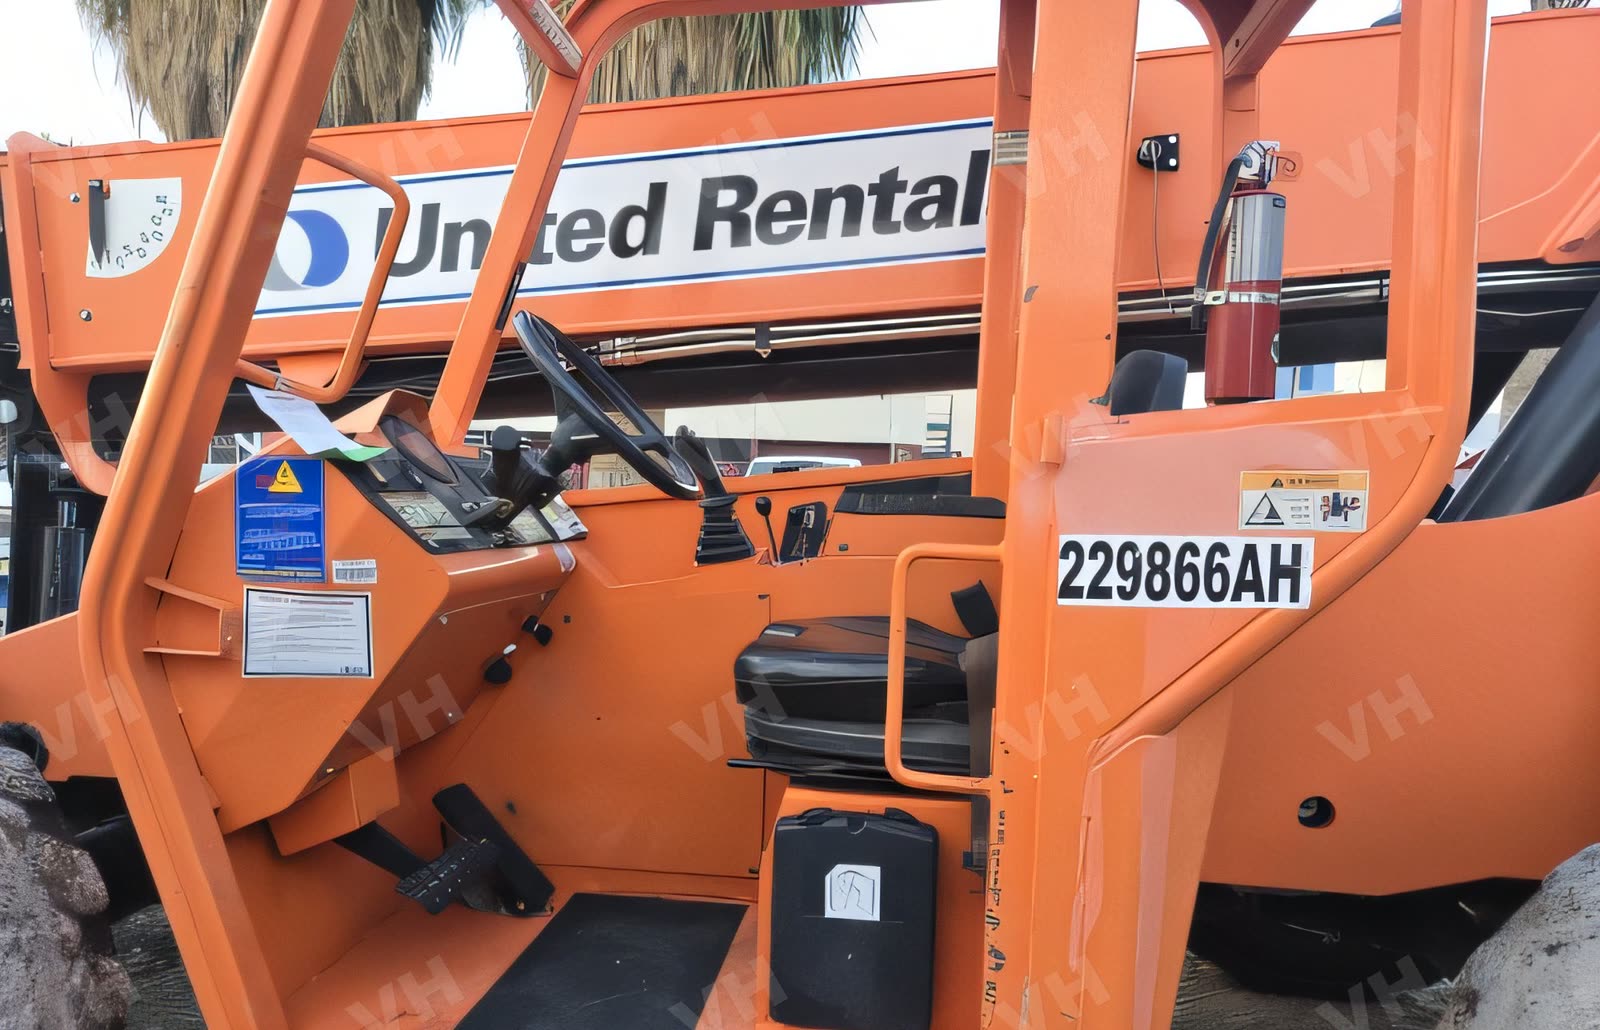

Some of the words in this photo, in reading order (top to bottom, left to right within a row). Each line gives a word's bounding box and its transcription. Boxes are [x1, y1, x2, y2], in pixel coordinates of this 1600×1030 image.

[374, 182, 668, 278] Unted
[693, 149, 990, 252] Rental
[1058, 540, 1302, 603] 229866AH
